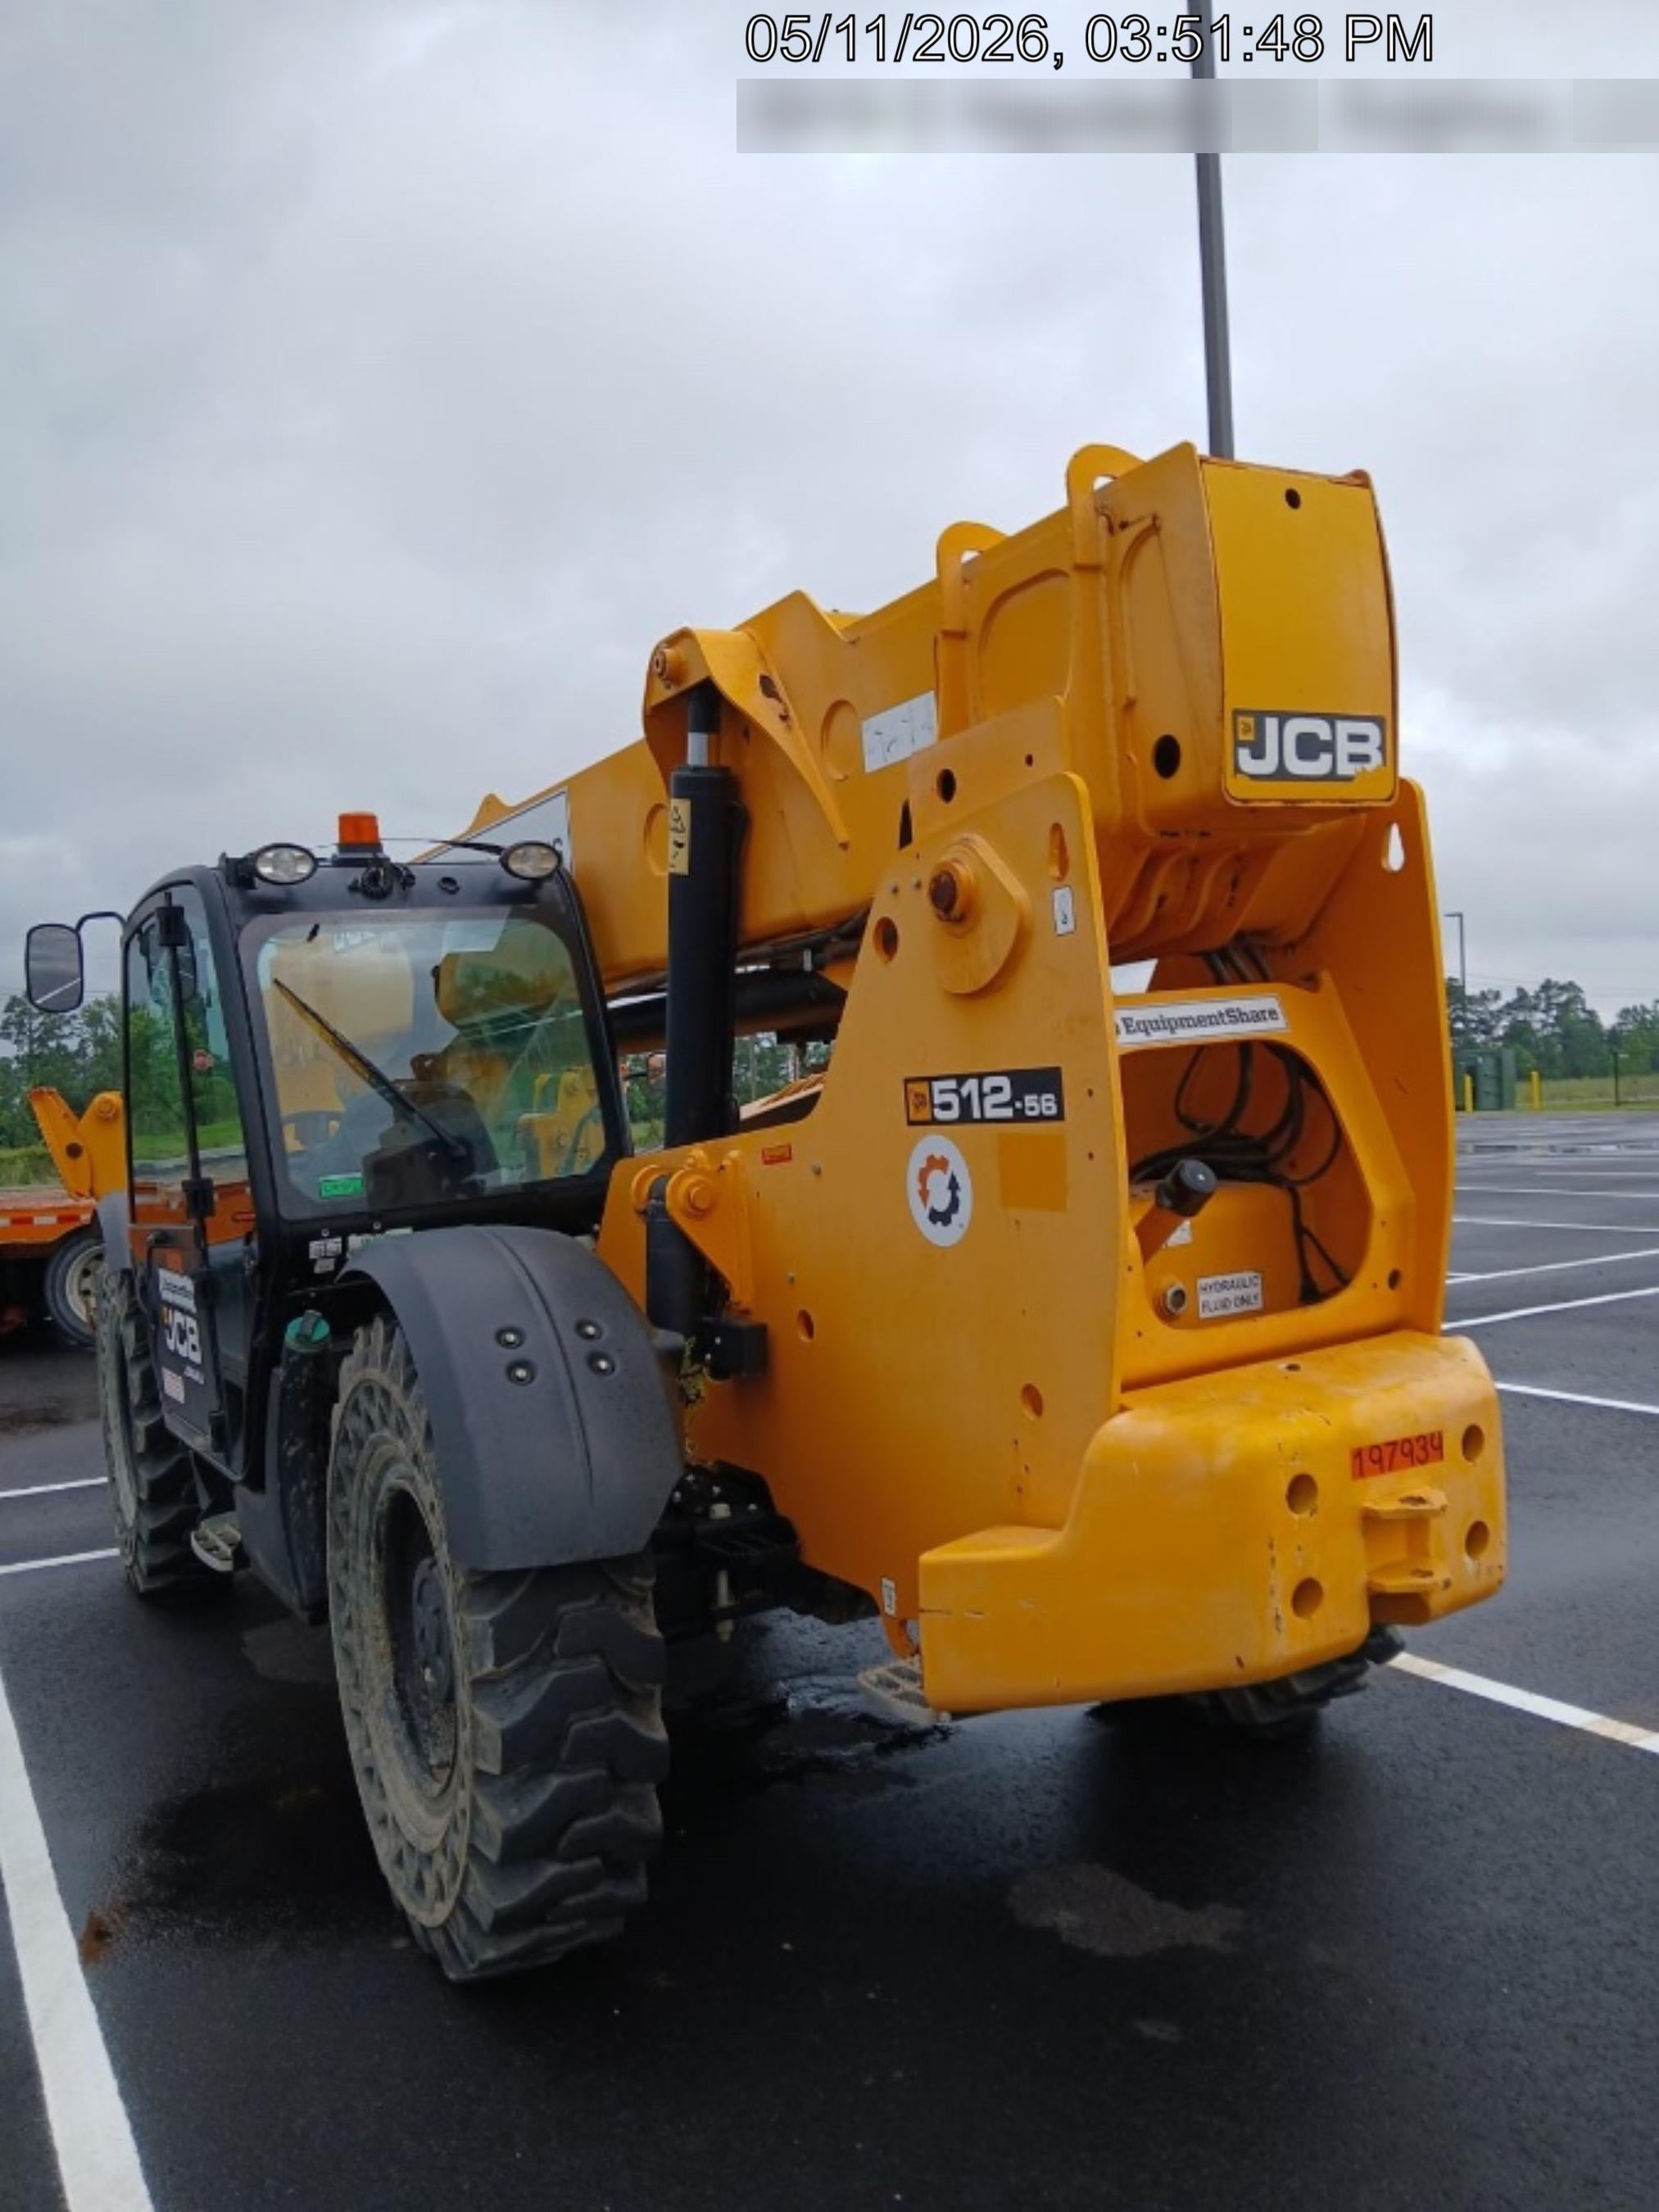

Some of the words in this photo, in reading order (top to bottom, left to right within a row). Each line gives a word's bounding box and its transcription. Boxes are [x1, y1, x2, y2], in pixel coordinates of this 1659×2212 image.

[1238, 717, 1383, 776] JCB
[1122, 1008, 1278, 1036] EquipmentShare
[931, 1075, 1058, 1122] 512-56
[165, 1308, 202, 1364] JCB
[1353, 1430, 1444, 1478] 197934
